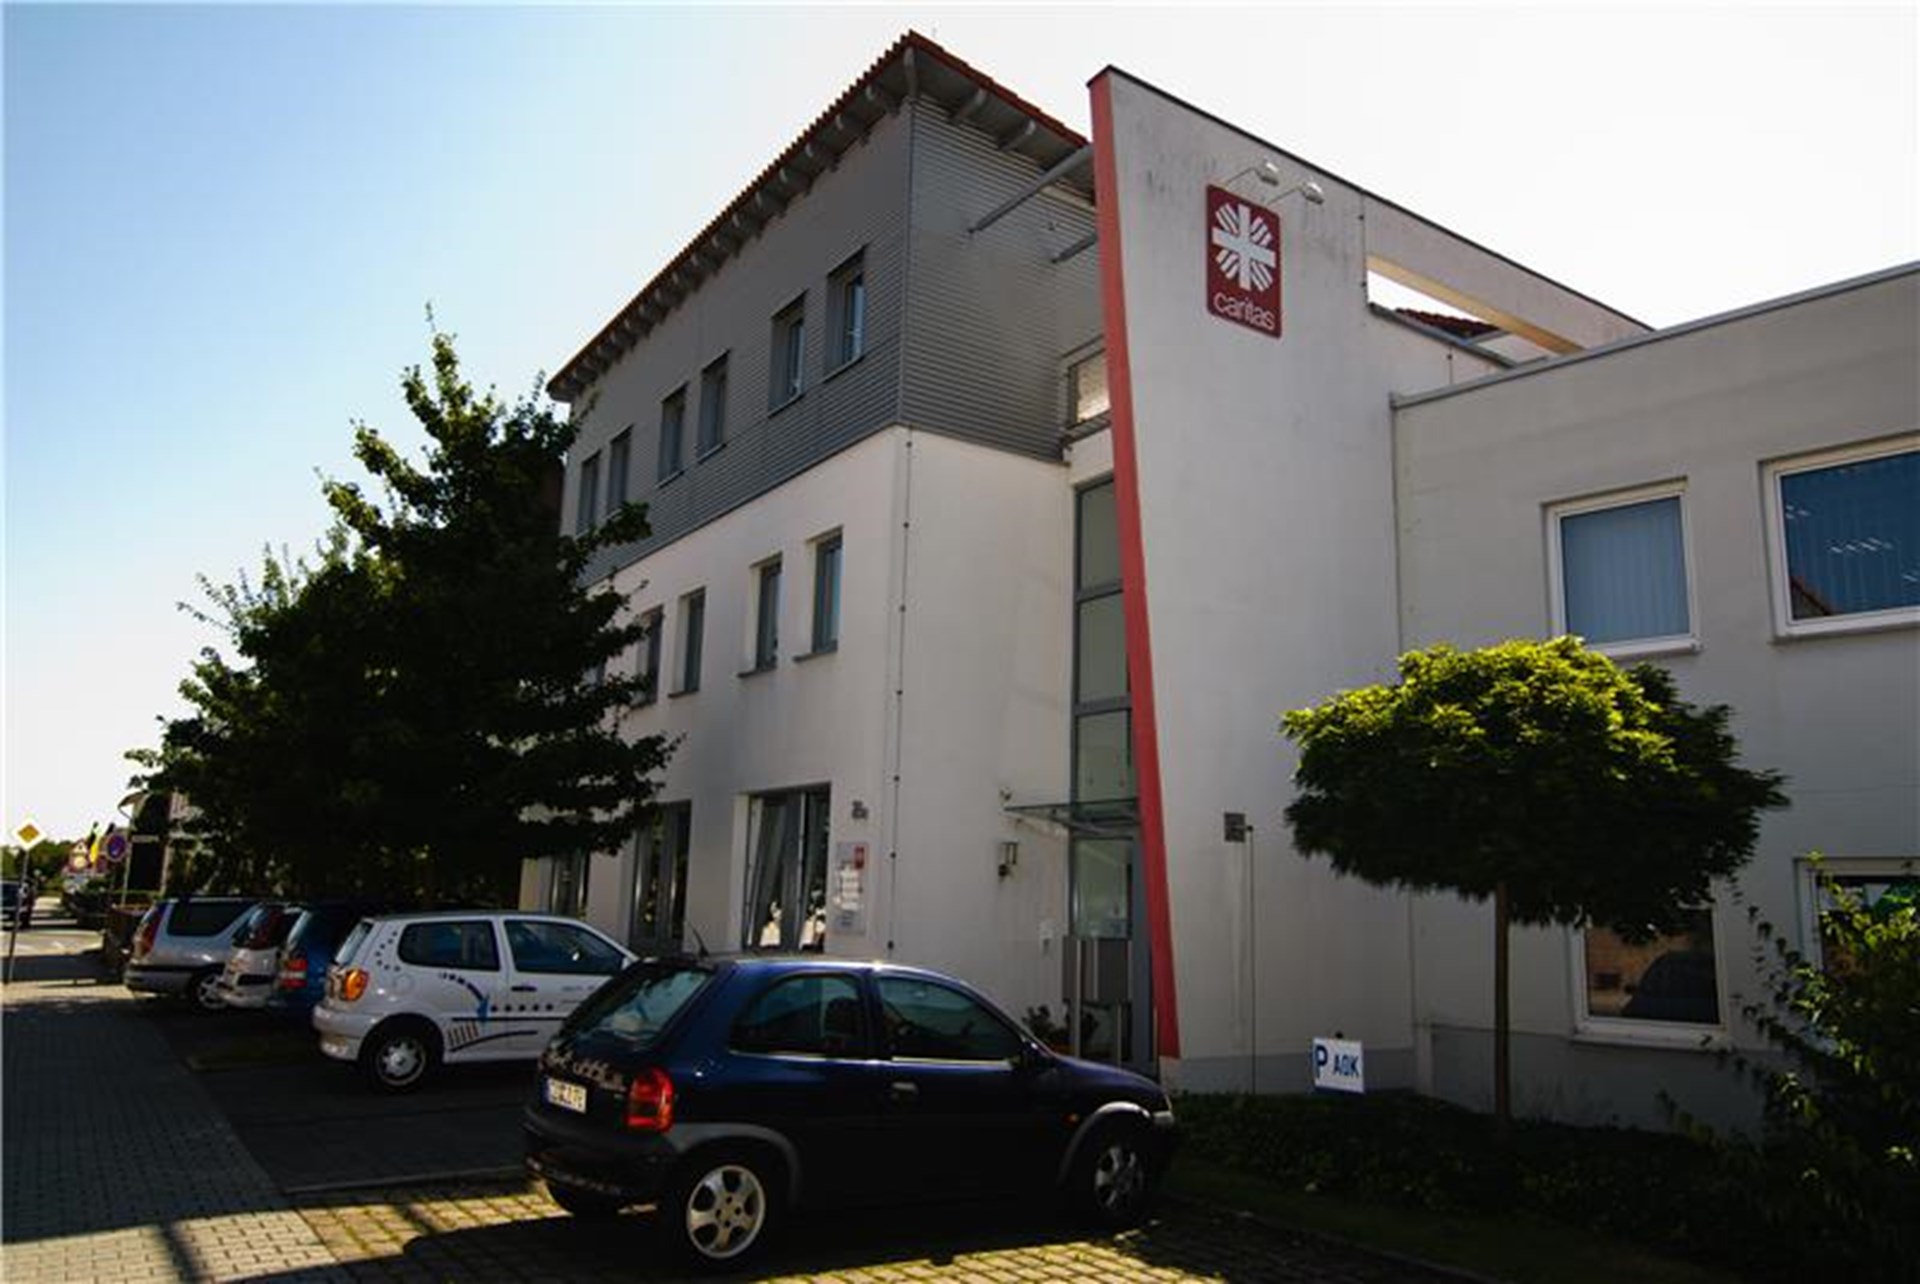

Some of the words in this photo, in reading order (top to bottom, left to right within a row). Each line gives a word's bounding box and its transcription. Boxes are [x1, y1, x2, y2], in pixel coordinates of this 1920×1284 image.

[1213, 292, 1275, 331] caritas
[1314, 1045, 1328, 1080] P
[1333, 1054, 1359, 1077] AOK
